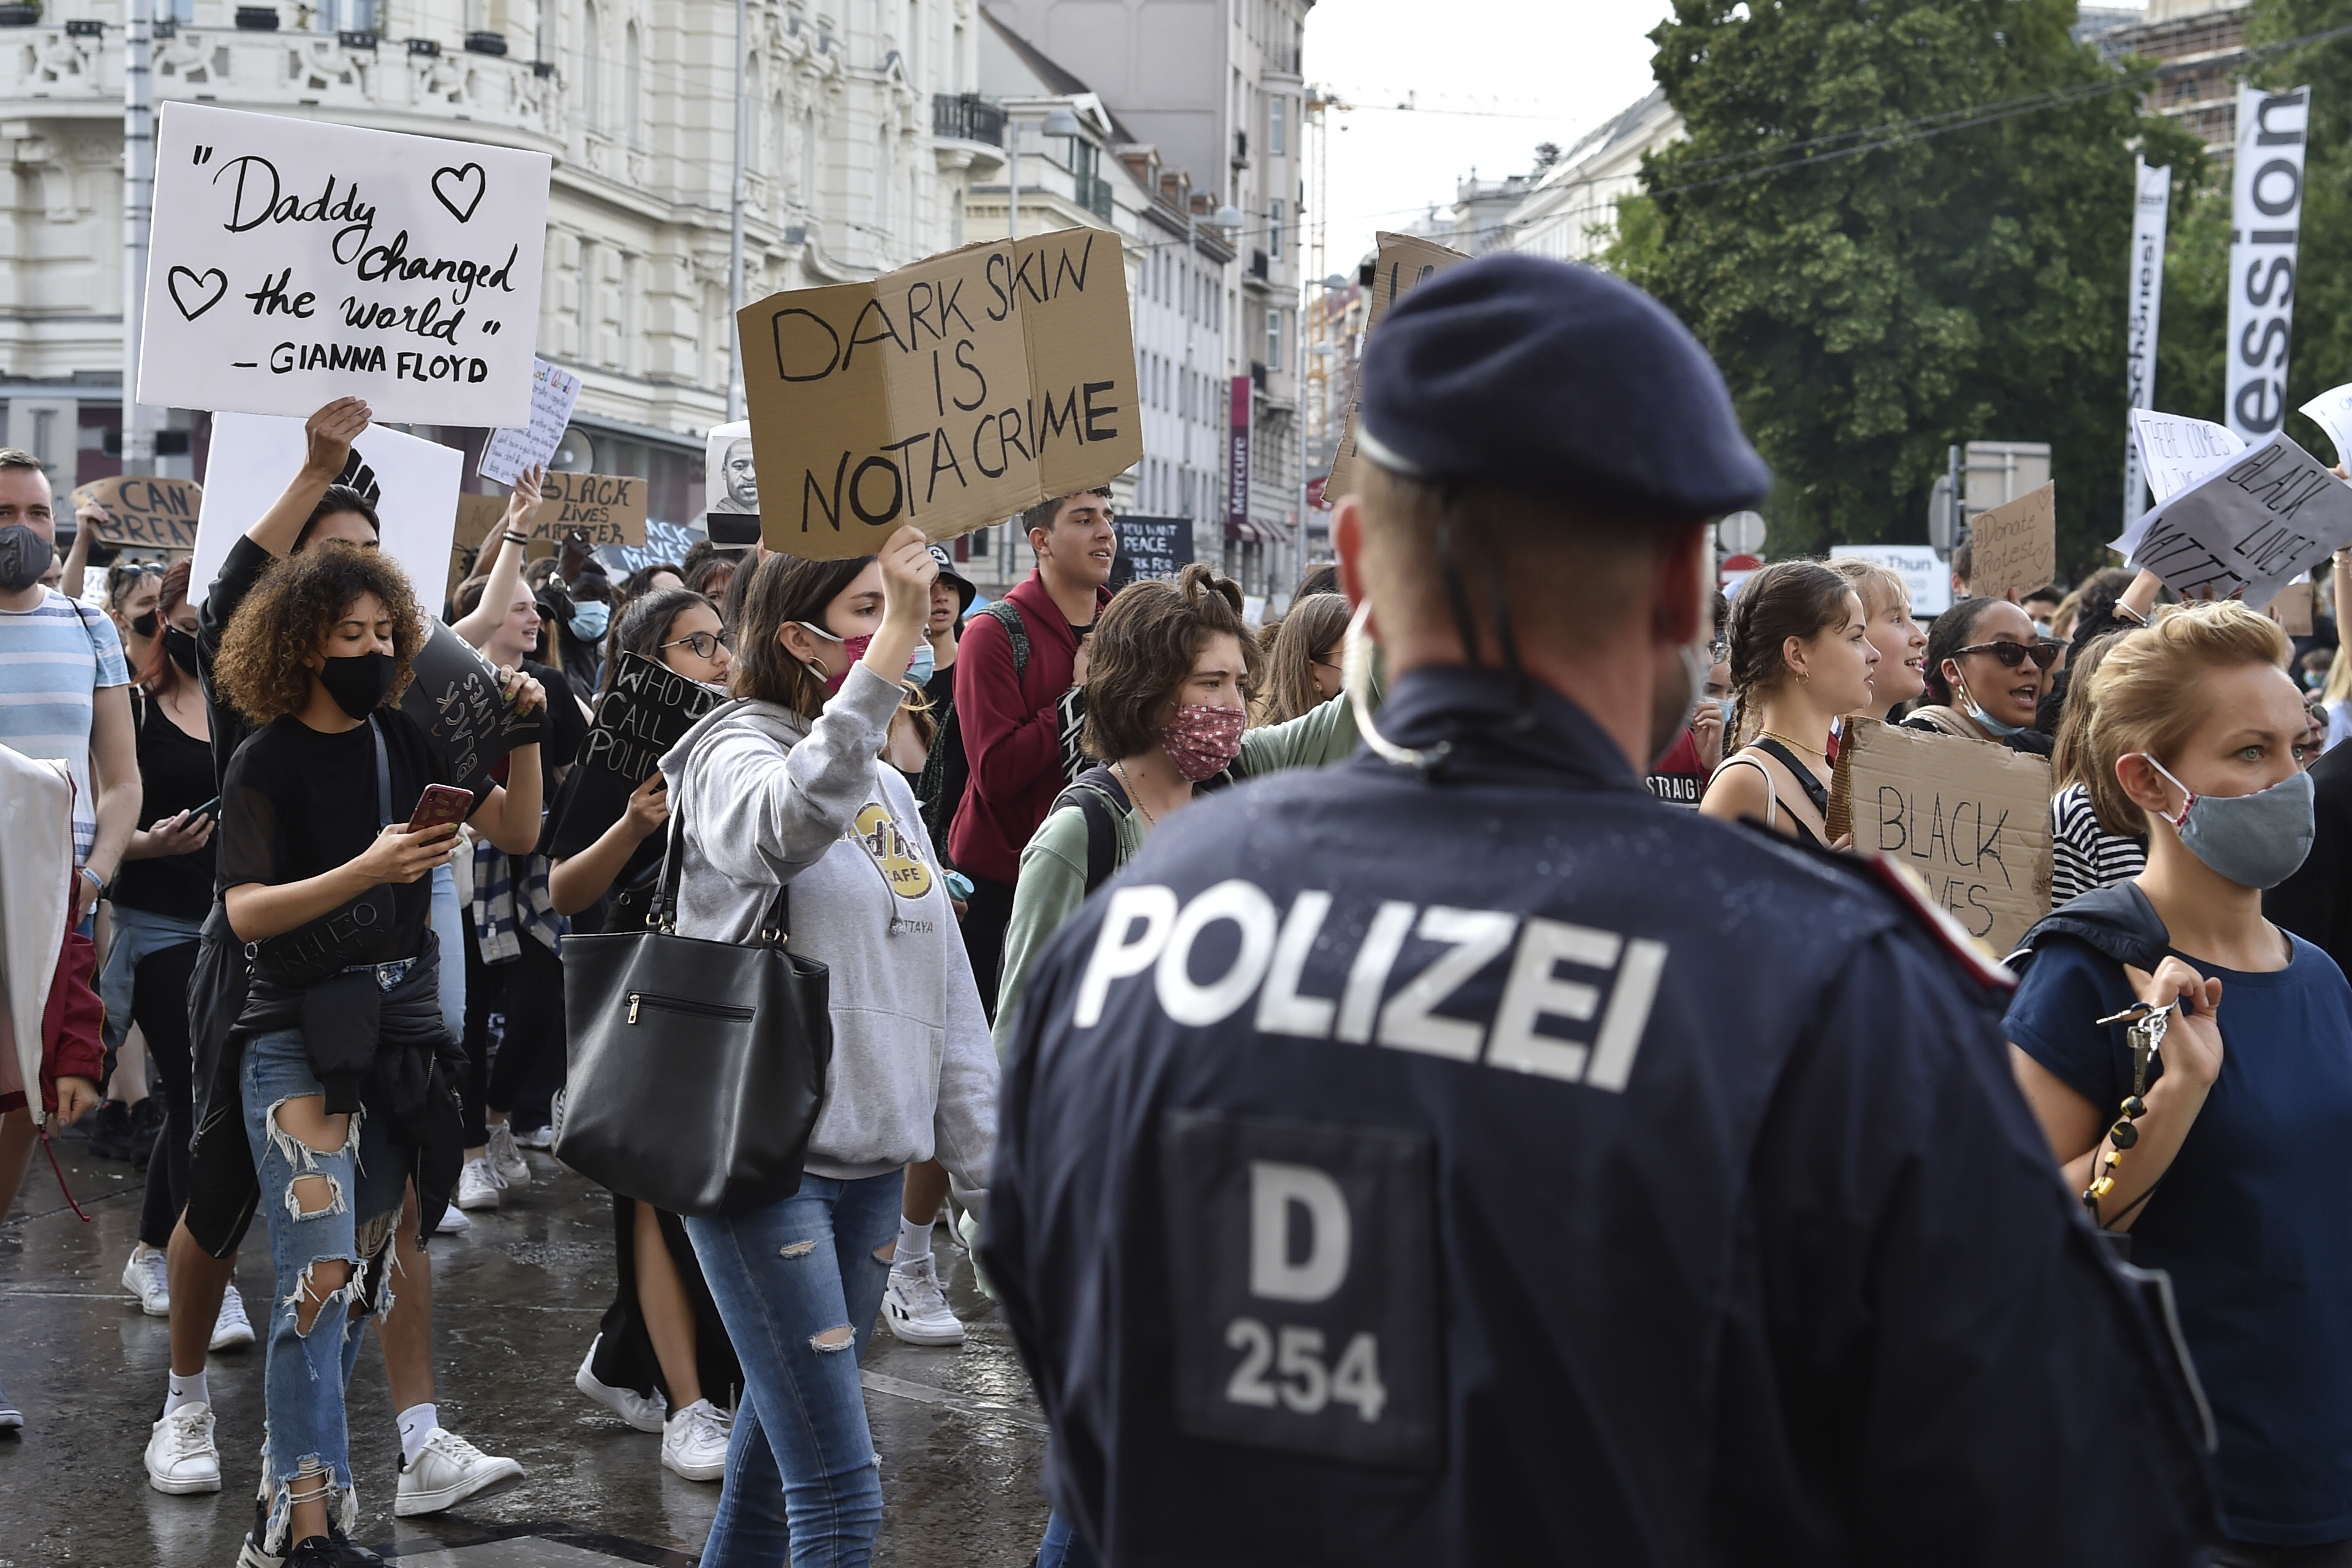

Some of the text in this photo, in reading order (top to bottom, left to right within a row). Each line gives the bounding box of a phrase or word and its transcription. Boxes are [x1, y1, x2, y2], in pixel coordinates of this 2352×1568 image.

[245, 267, 315, 317] the
[357, 230, 519, 305] changed
[772, 233, 1093, 382] DARK SKIN
[270, 342, 386, 374] GIANNA
[396, 352, 488, 383] FLOYD
[933, 339, 987, 417] IS
[541, 473, 632, 507] BLACK
[802, 380, 1118, 533] NOT A CRIME
[1231, 436, 1247, 516] Mercure
[2226, 443, 2331, 521] BLACK
[1121, 522, 1144, 536] YOU
[1145, 523, 1178, 537] WANT
[1152, 556, 1174, 570] FOR
[2233, 519, 2316, 576] LIVES
[463, 673, 496, 739] LIVES
[617, 655, 684, 706] WHO
[435, 680, 478, 782] BLACK
[598, 692, 665, 746] CALL
[1878, 785, 2013, 891] BLACK
[274, 902, 378, 973] KENZO
[1072, 878, 1669, 1093] POLIZEI
[1248, 1158, 1352, 1303] D
[1224, 1315, 1387, 1425] 254
